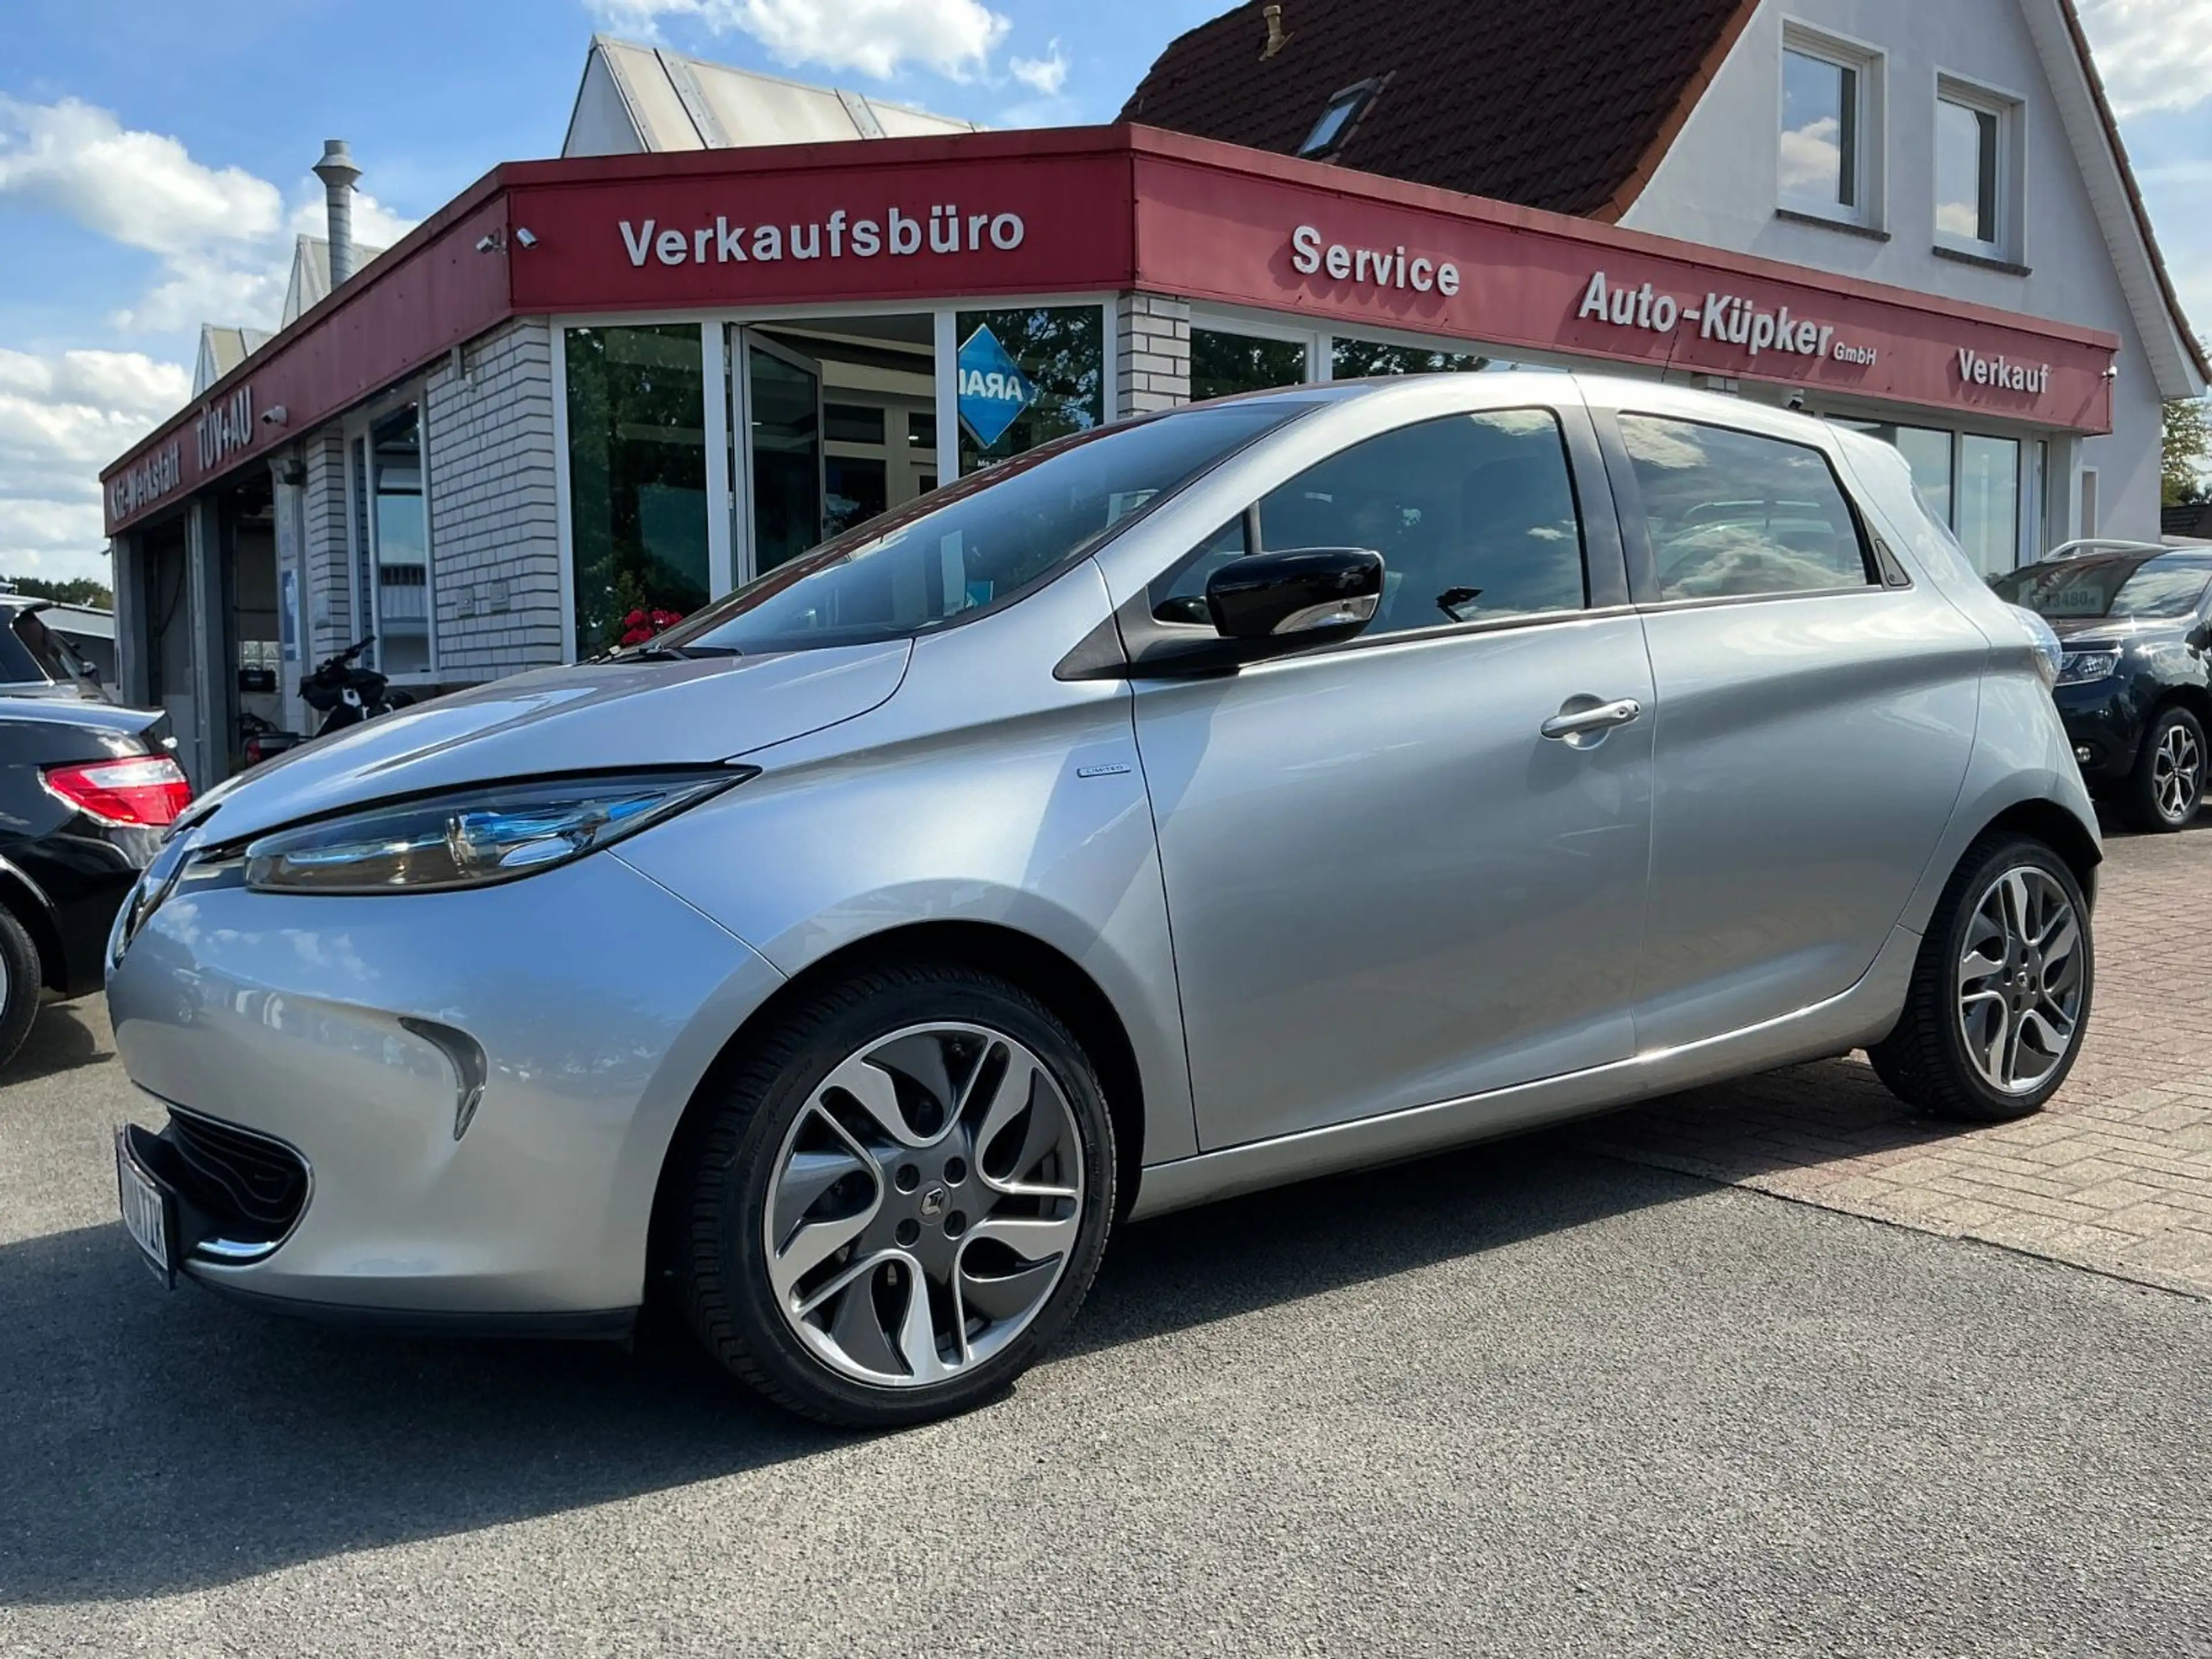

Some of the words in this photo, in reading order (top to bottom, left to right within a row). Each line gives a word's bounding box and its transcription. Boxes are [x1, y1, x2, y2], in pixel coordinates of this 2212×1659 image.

[619, 204, 1025, 267] Verkaufsbüro
[1292, 225, 1460, 296] Service
[1578, 271, 1834, 356] Auto-Küpker
[1833, 341, 1877, 366] GmbH
[1959, 347, 2049, 393] Verkauf
